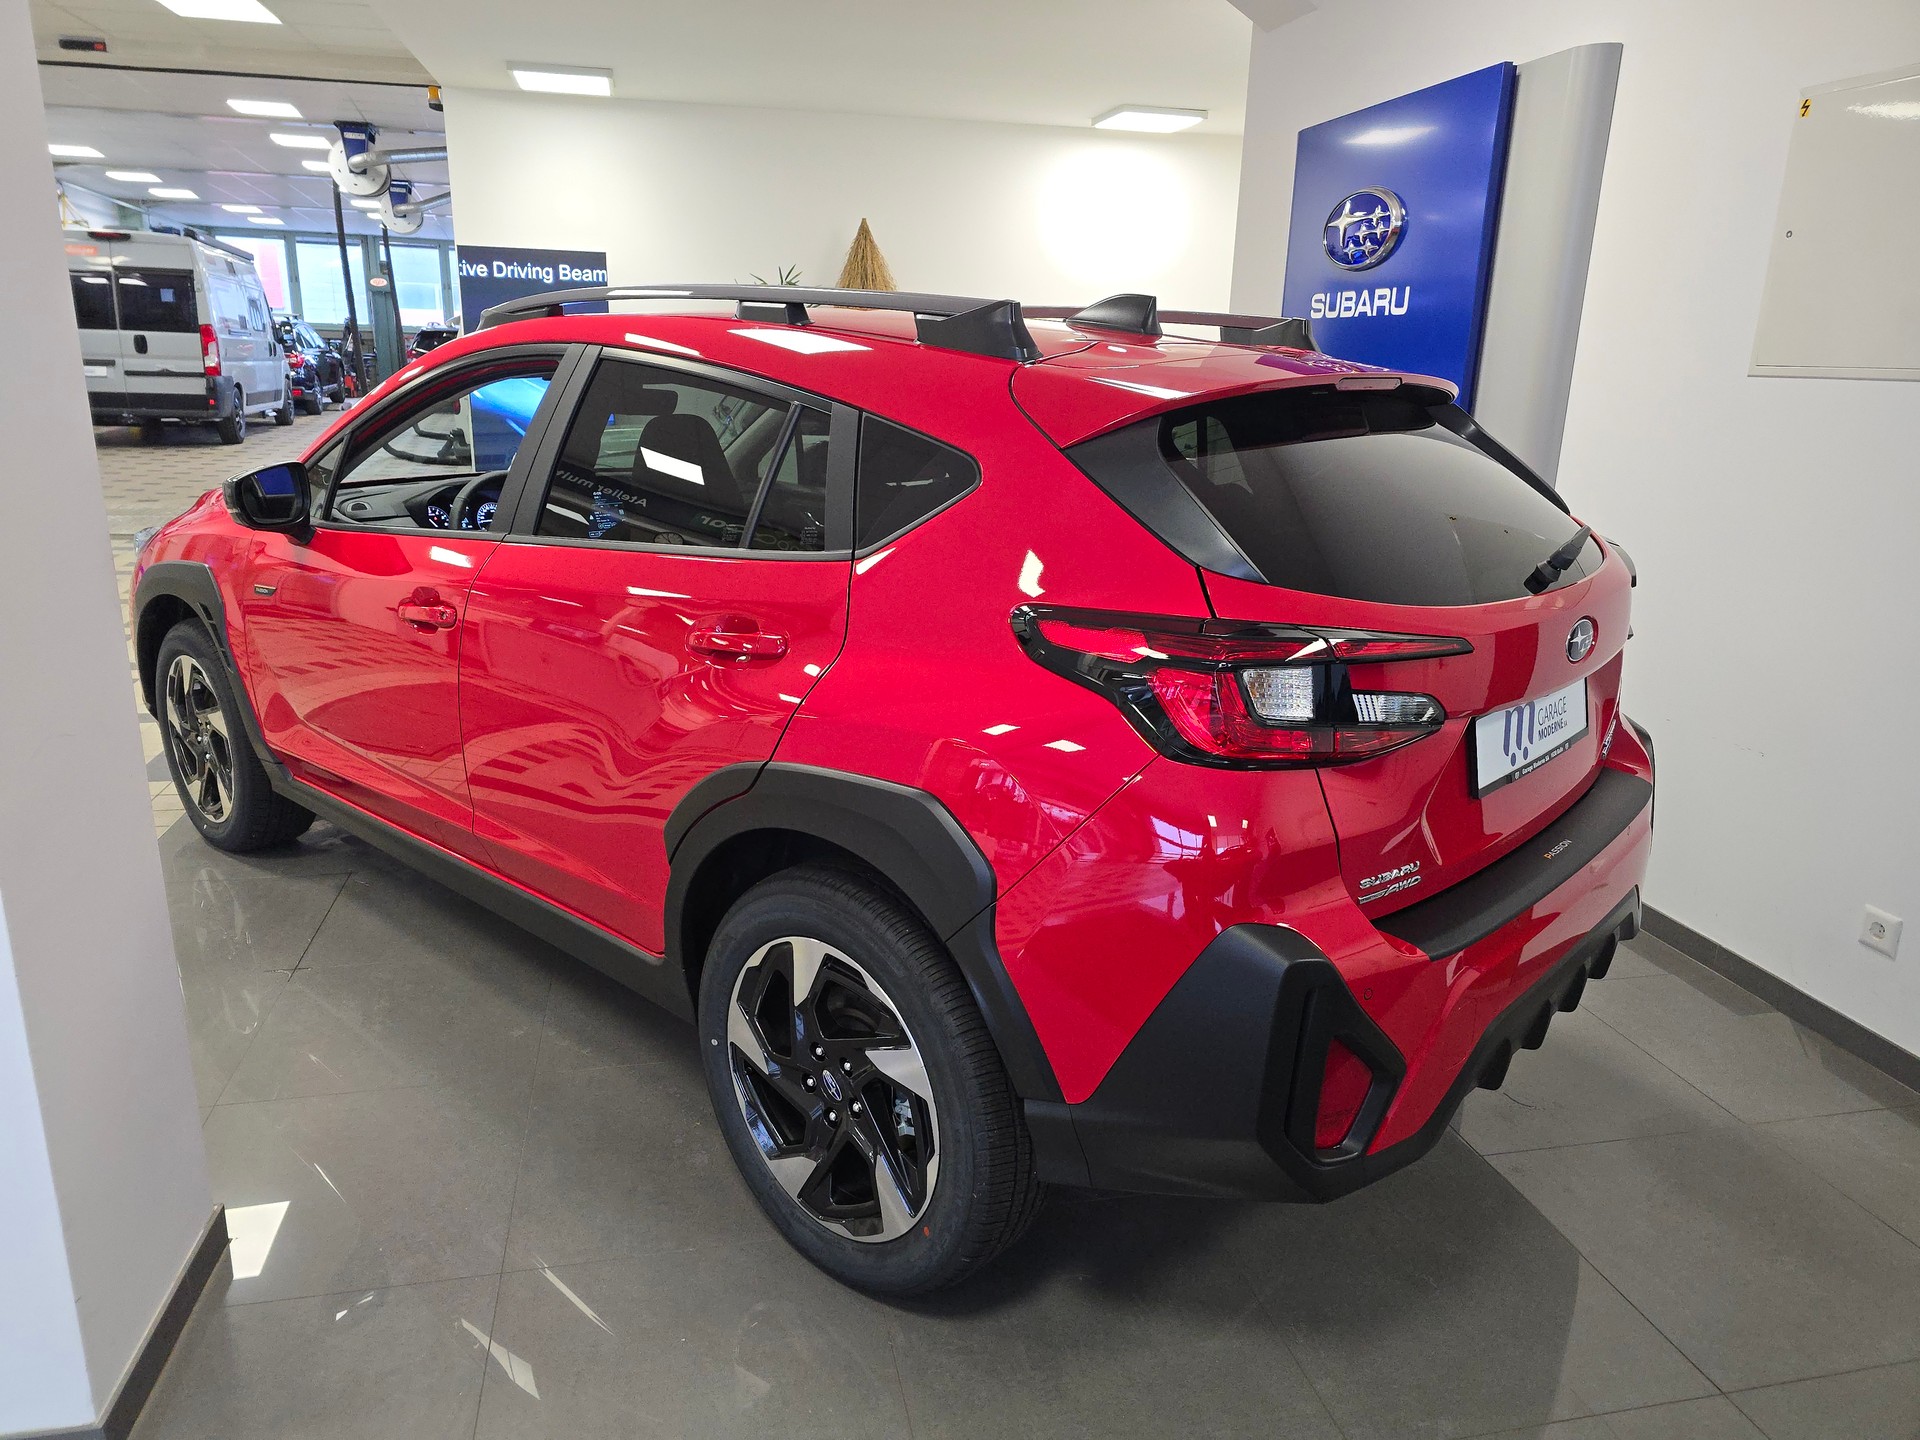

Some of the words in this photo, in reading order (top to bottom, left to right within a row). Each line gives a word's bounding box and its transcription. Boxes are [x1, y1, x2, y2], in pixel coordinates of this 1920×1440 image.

[493, 261, 553, 283] Driving
[558, 264, 608, 282] Beam
[1310, 286, 1411, 319] SUBARU
[1538, 696, 1567, 726] GARAGE
[1538, 718, 1563, 741] MODERNE
[1543, 838, 1572, 860] PASSION
[1359, 860, 1420, 889] SUBARU
